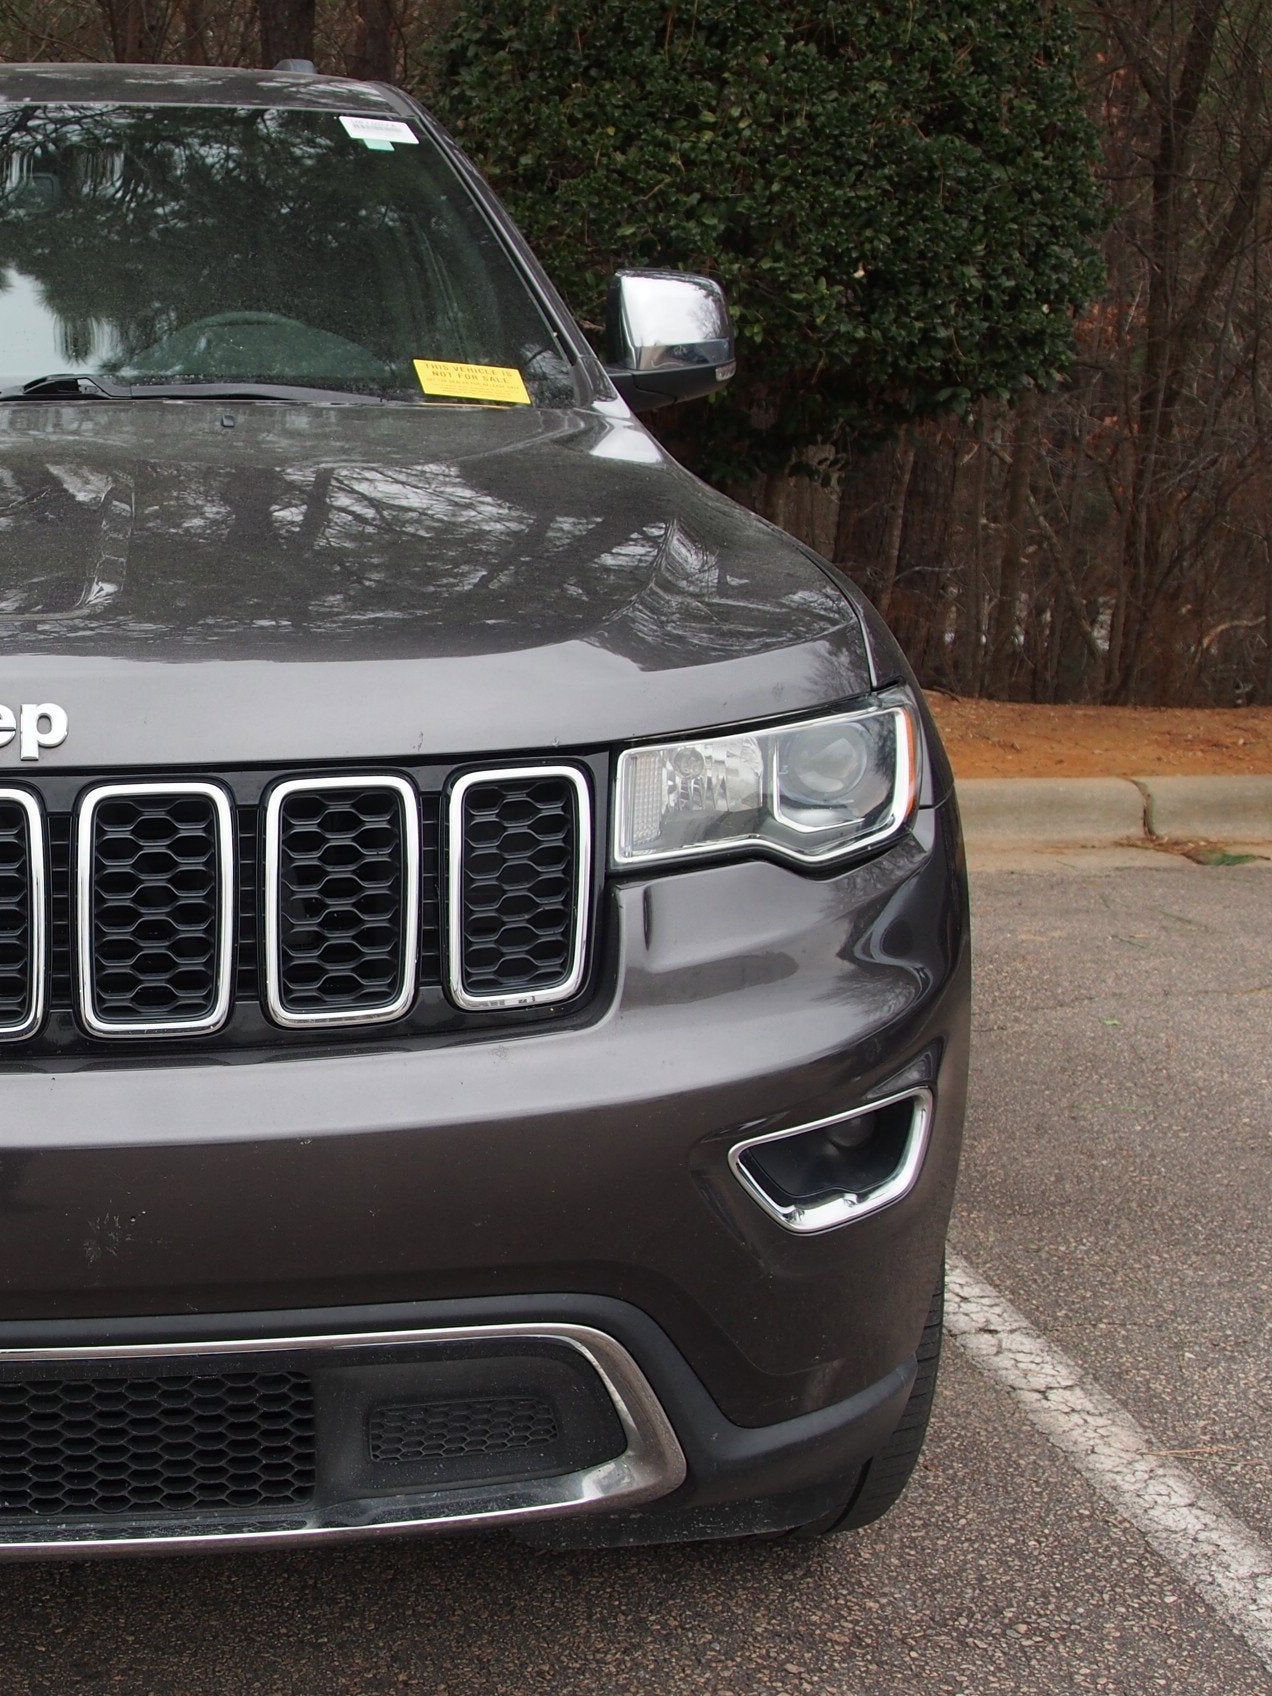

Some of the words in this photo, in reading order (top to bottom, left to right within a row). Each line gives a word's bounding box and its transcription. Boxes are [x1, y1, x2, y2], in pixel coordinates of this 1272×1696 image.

[425, 363, 449, 371] THIS
[453, 365, 497, 375] VEHICLE
[501, 370, 513, 378] IS
[458, 373, 478, 381] FOR
[482, 375, 509, 384] SALE
